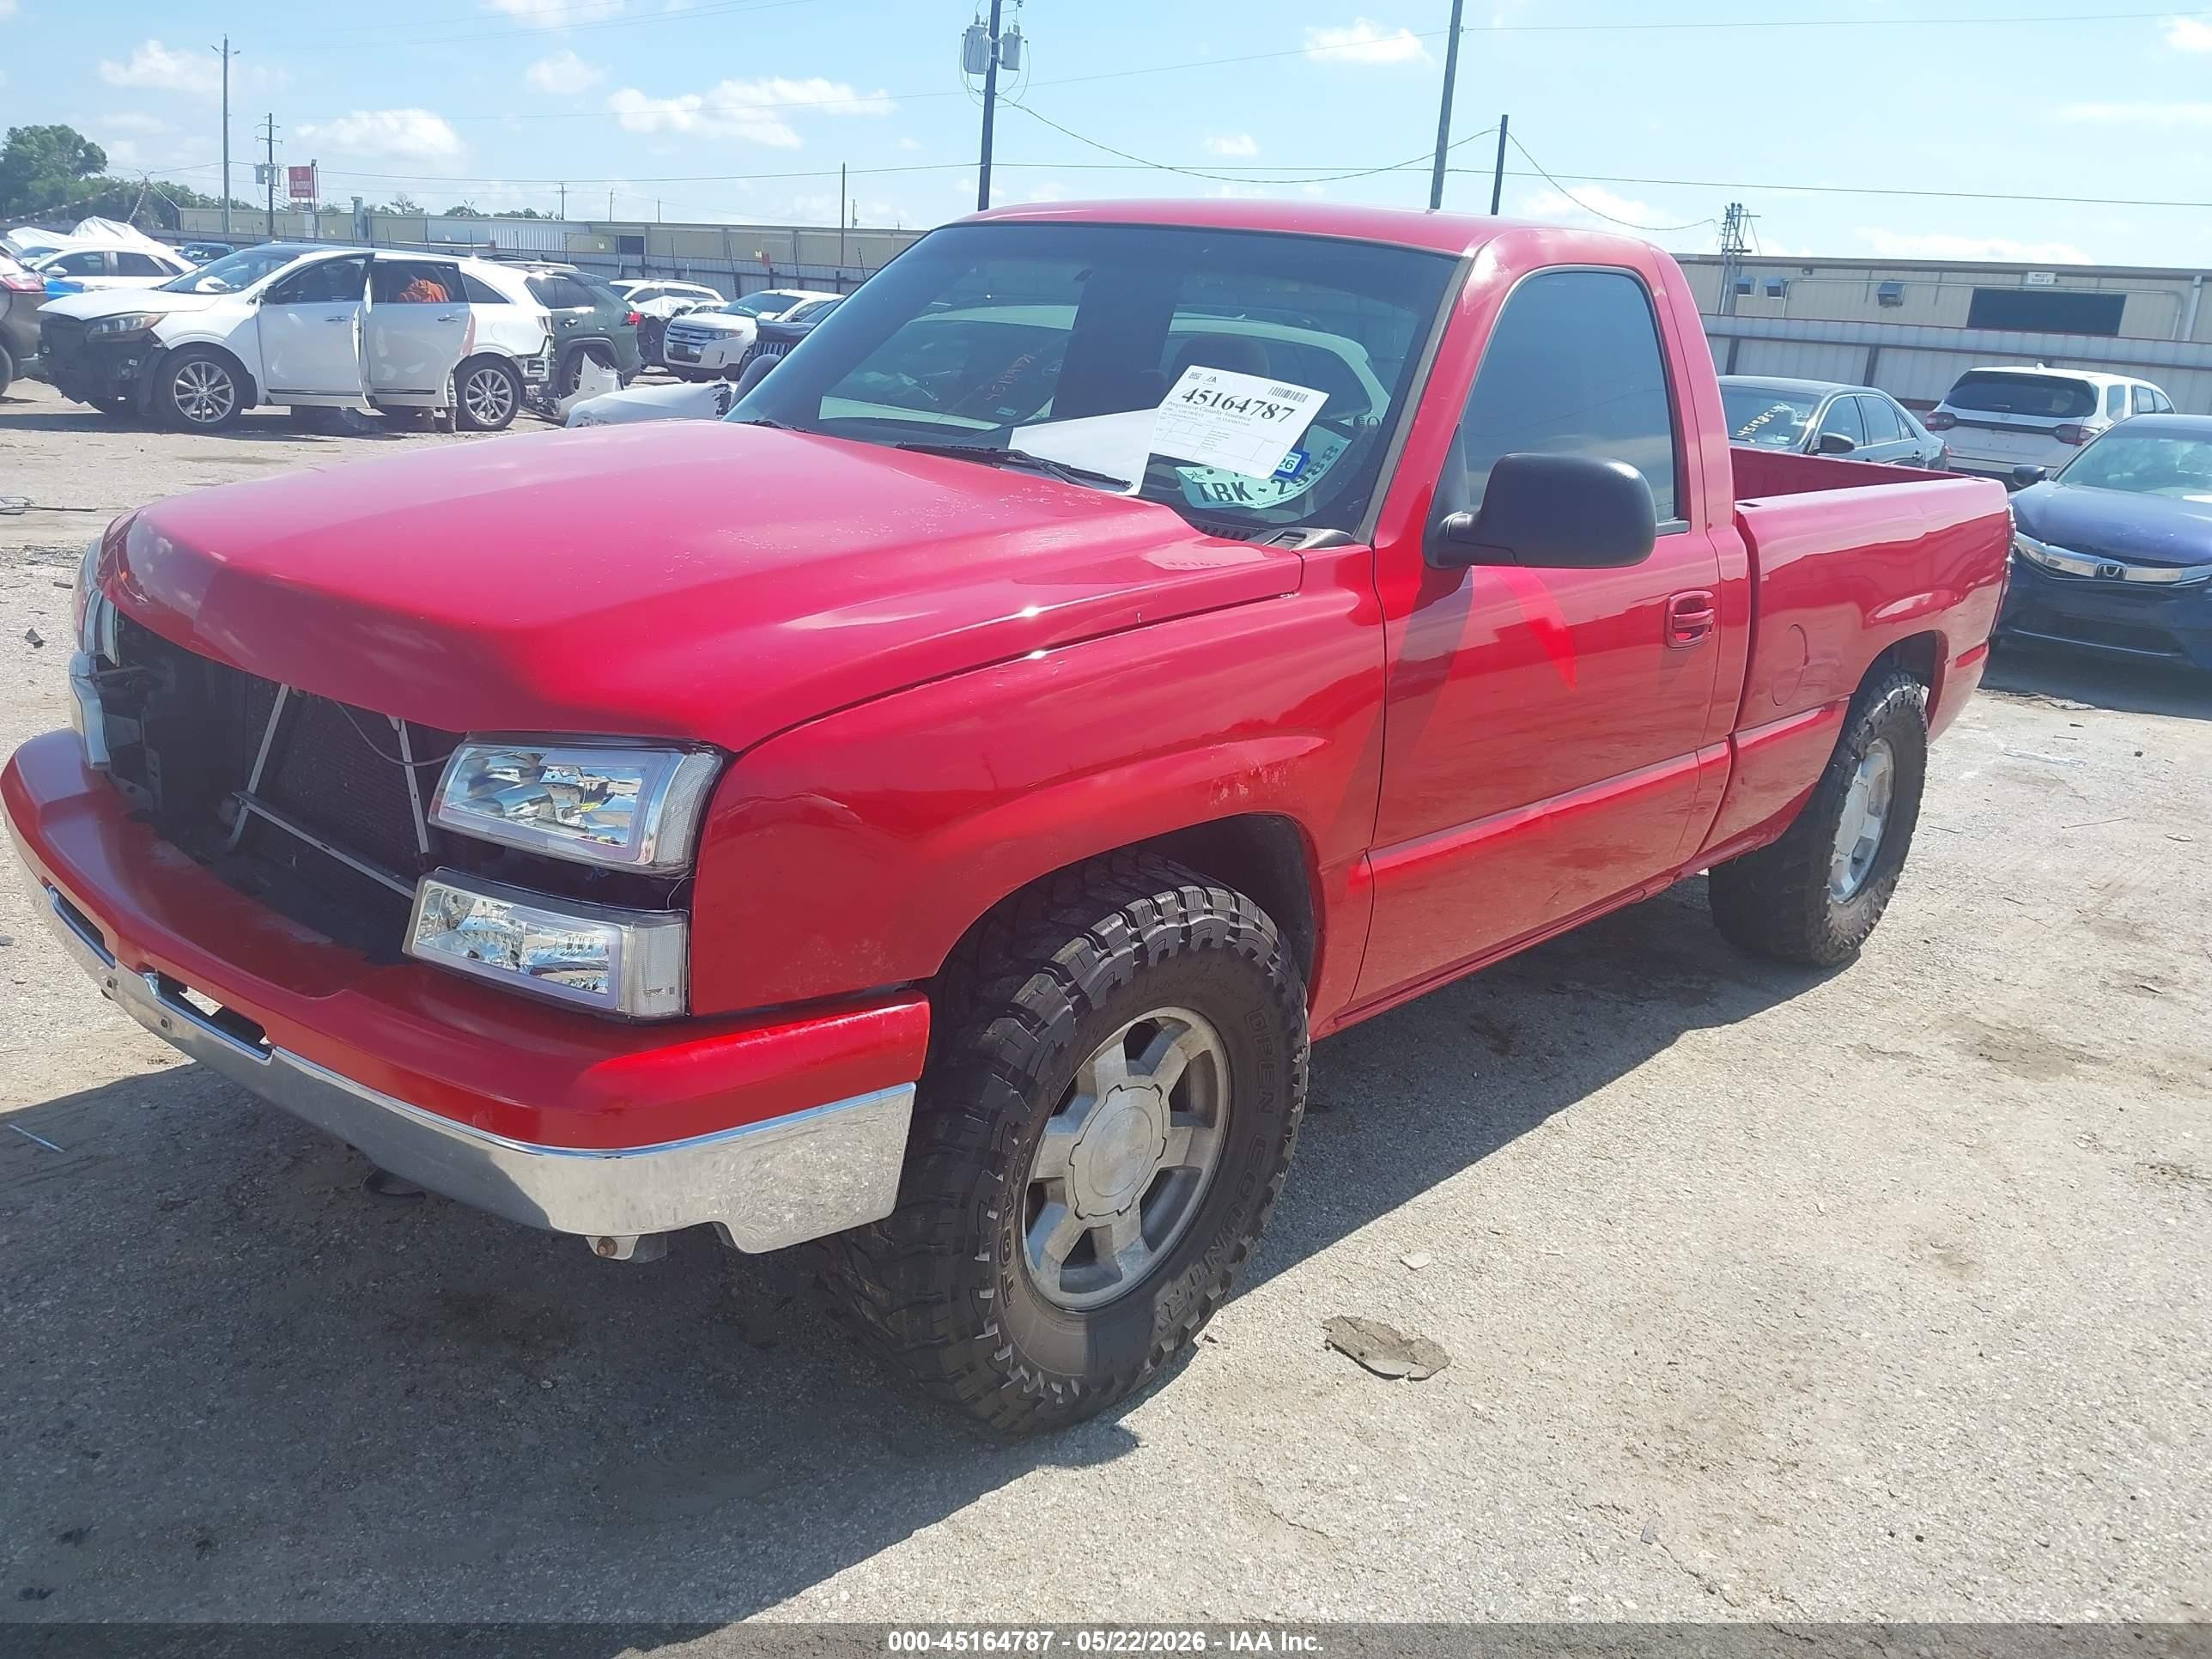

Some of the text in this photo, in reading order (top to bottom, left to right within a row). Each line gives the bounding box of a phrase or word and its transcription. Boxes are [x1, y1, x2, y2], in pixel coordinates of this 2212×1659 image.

[1181, 386, 1297, 424] 45164787
[1193, 480, 1255, 502] TBK
[1243, 1008, 1276, 1115] OPEN
[1000, 1135, 1033, 1309] TOYO
